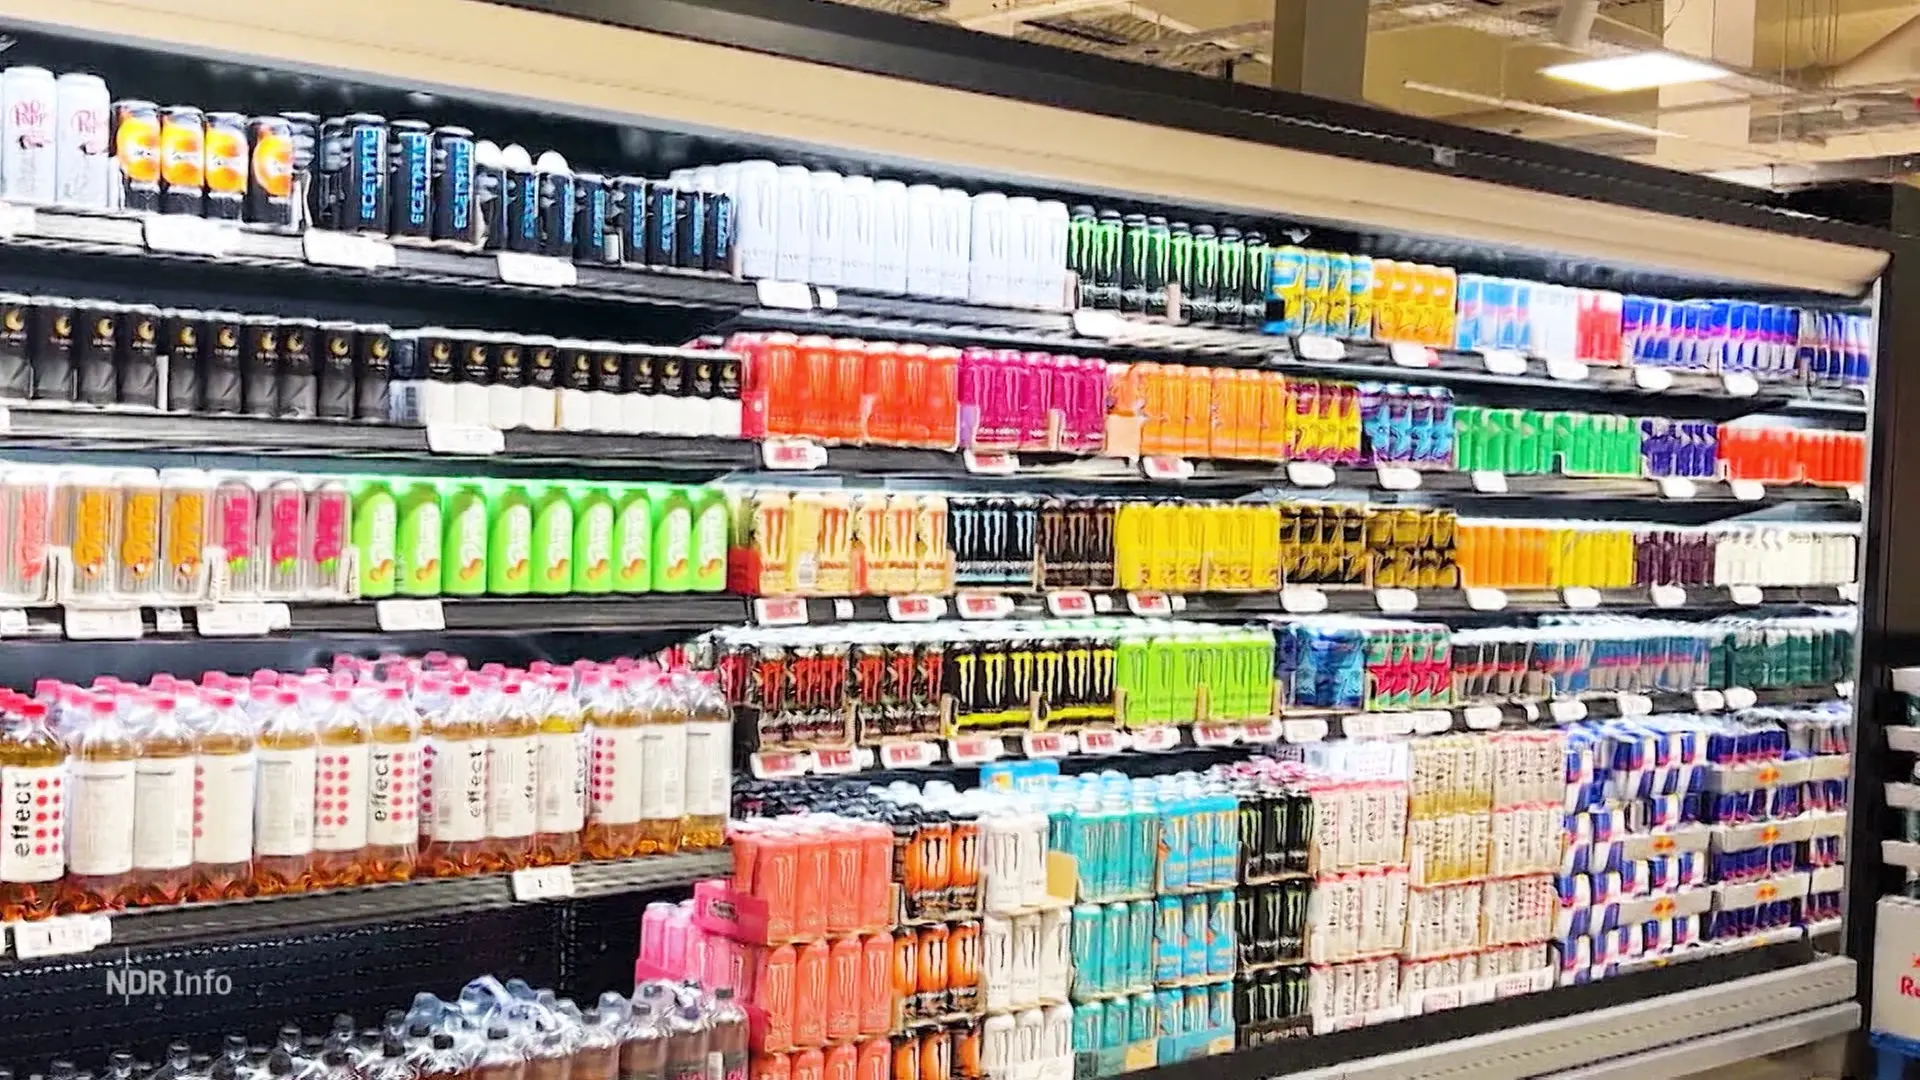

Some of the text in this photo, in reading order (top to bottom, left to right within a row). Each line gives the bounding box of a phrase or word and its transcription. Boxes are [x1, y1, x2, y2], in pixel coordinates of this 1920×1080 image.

[370, 754, 389, 822] effect
[466, 751, 482, 818] effect
[10, 781, 32, 857] effect
